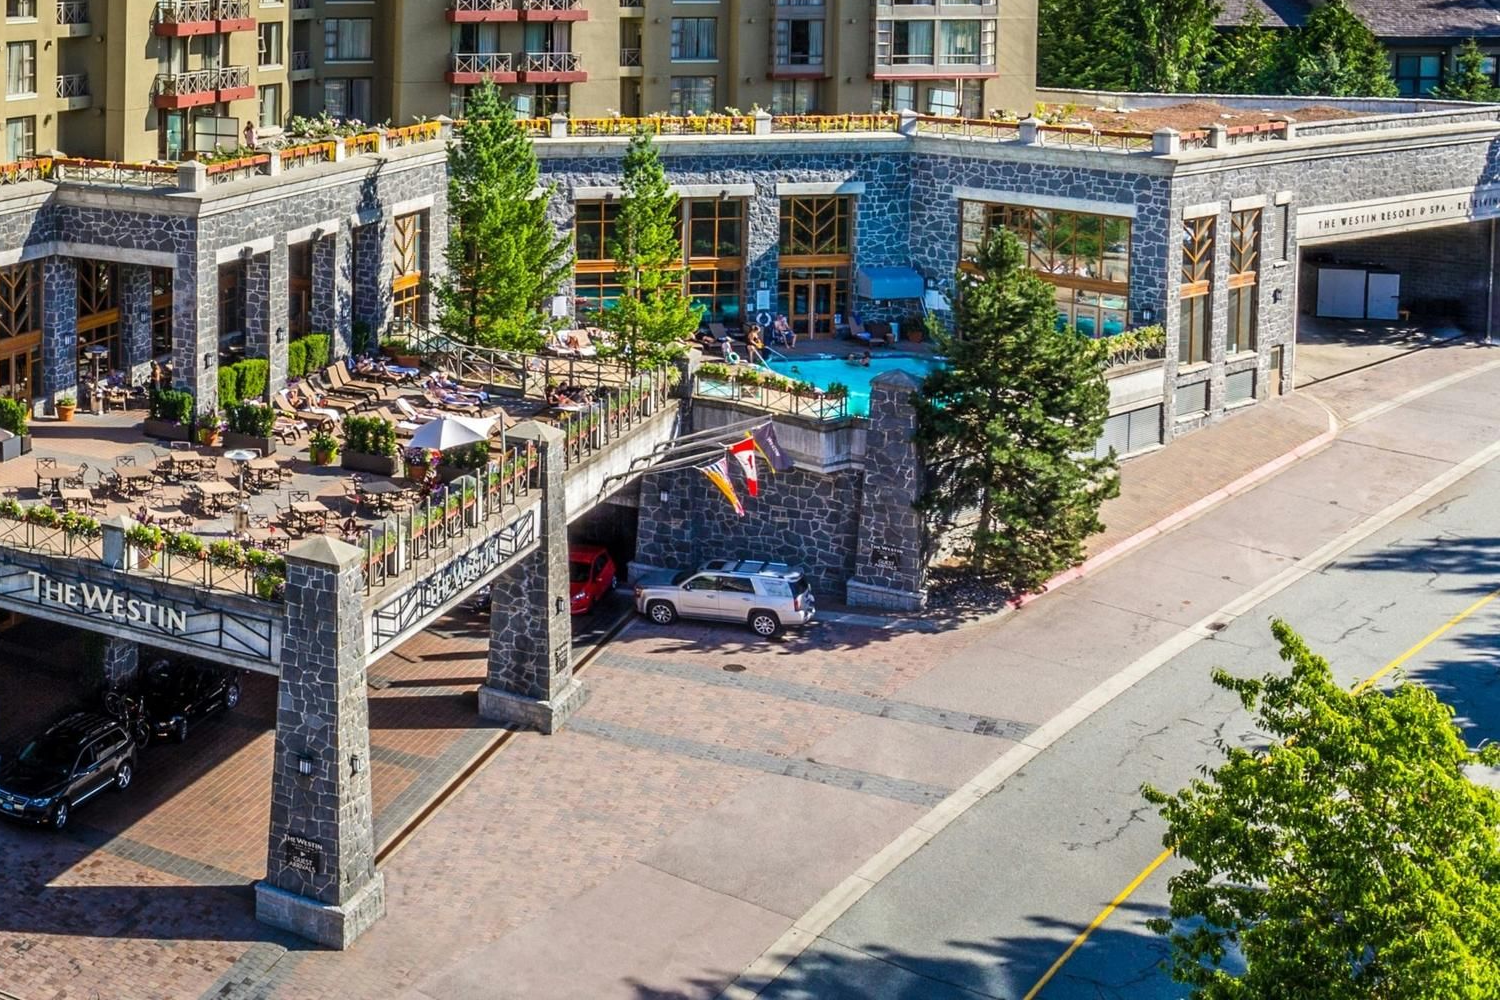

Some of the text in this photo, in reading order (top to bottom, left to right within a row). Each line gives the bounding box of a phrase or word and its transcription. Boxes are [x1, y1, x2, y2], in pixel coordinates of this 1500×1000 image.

[1318, 219, 1336, 229] THE
[1341, 213, 1376, 226] WESTIN
[1381, 207, 1415, 221] RESORT
[1430, 204, 1446, 214] SPA
[27, 570, 187, 632] THE WESTIN
[296, 837, 323, 850] WESTIN
